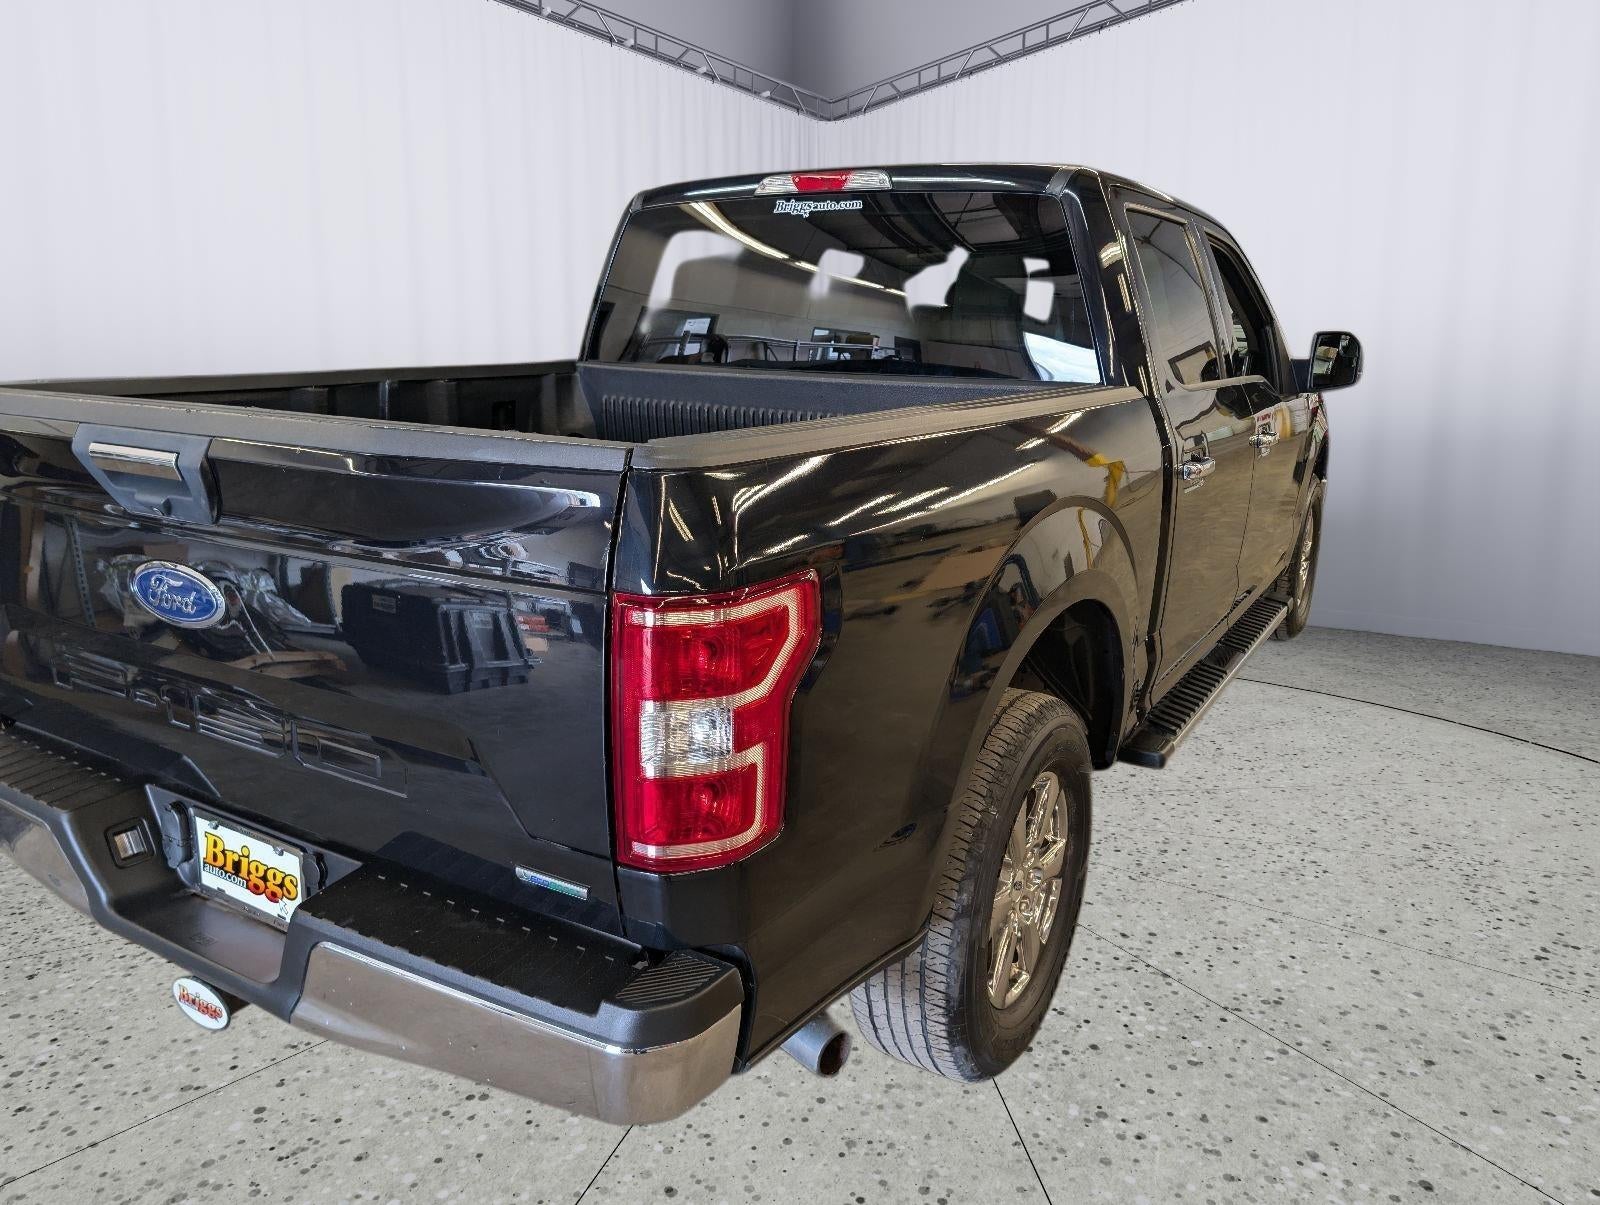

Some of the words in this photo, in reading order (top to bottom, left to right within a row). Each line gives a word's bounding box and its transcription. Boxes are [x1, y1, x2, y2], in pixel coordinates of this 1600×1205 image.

[774, 199, 863, 215] Briggsauto.com
[148, 574, 197, 615] Ford
[203, 831, 299, 904] Briggs
[203, 863, 247, 889] auto.com
